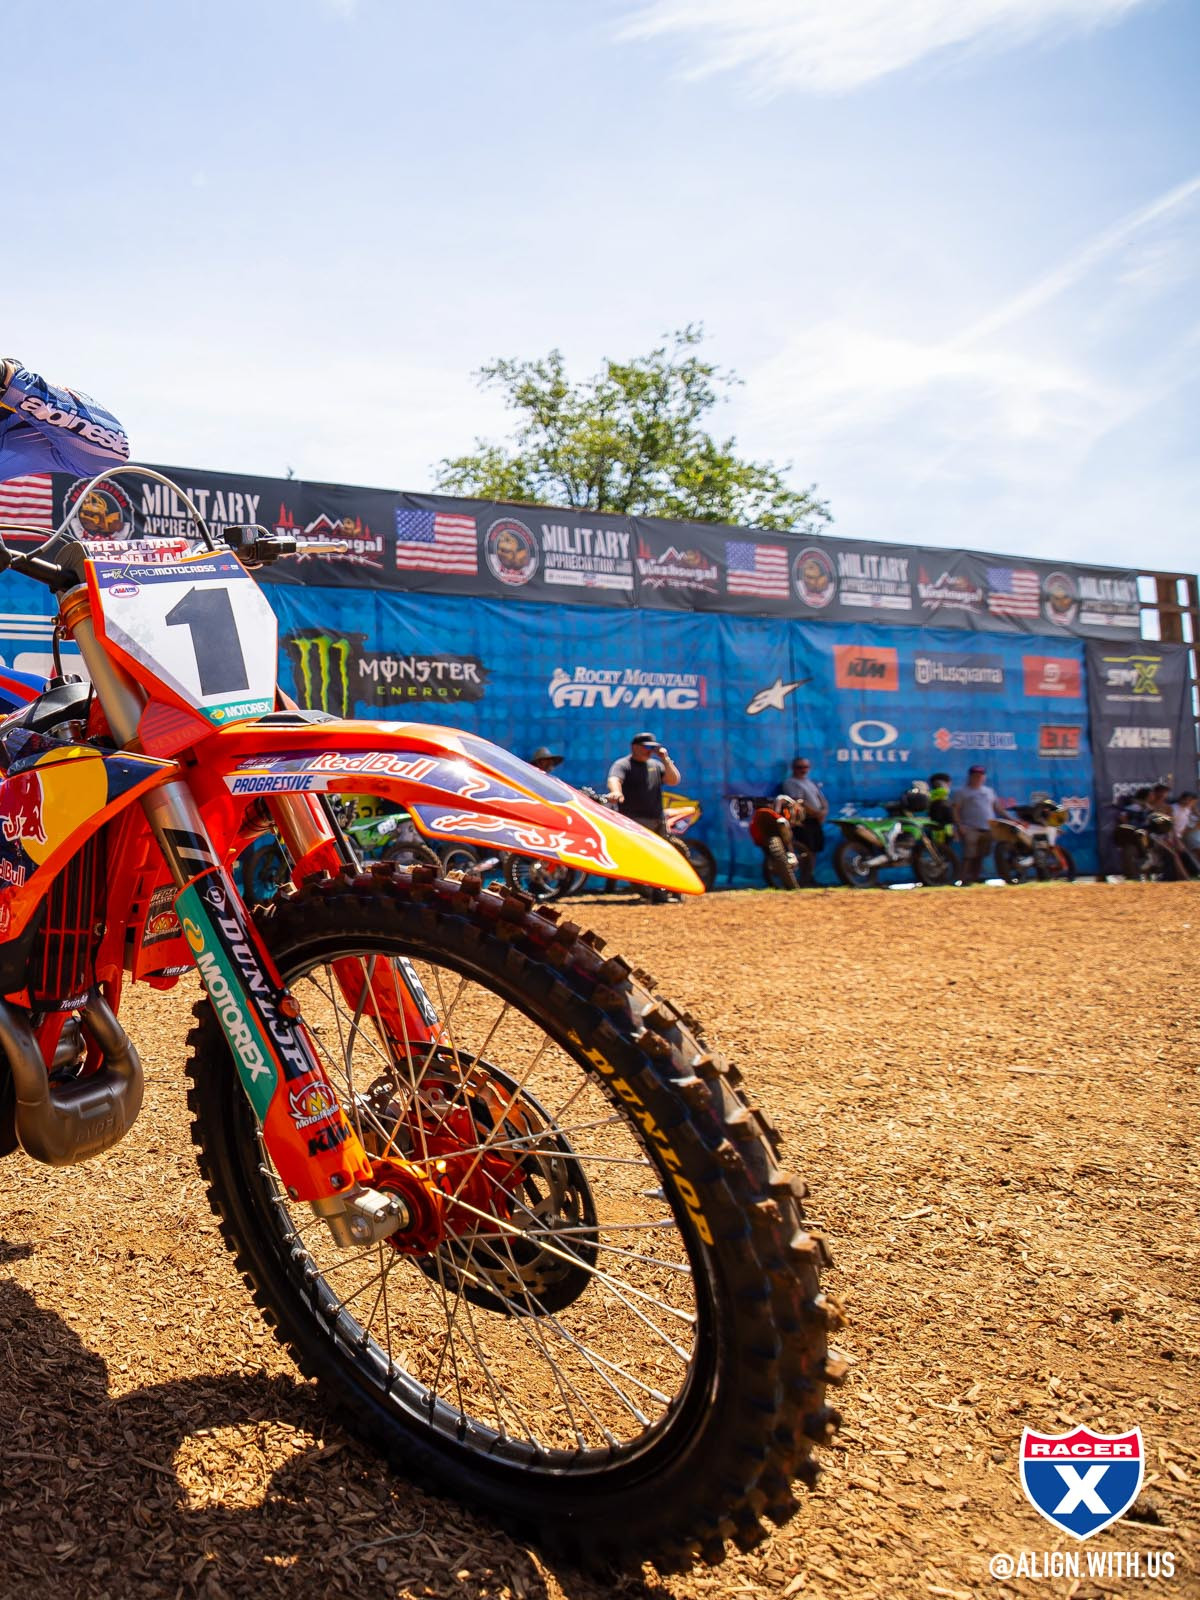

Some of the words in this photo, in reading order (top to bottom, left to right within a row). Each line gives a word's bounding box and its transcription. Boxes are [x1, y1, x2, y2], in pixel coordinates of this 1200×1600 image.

[142, 483, 260, 524] MILITARY
[88, 540, 181, 552] RENTHAL
[541, 524, 630, 559] MILITARY
[837, 552, 909, 582] MILITARY
[165, 586, 250, 696] 1
[358, 657, 481, 684] MONSTER
[574, 667, 621, 684] ROCKY
[624, 669, 698, 687] MOUNTAIN
[847, 657, 887, 679] KTM
[377, 686, 462, 697] ENERGY
[225, 701, 272, 718] MOTOREX
[308, 752, 373, 773] Red
[367, 752, 441, 782] Bull
[232, 775, 314, 793] PROGRESSIVE
[3, 860, 26, 888] Bull
[218, 917, 309, 1073] DUNLOP
[197, 952, 271, 1083] MOTOREX
[308, 1123, 352, 1157] KTM
[581, 1048, 715, 1246] DUNLOP
